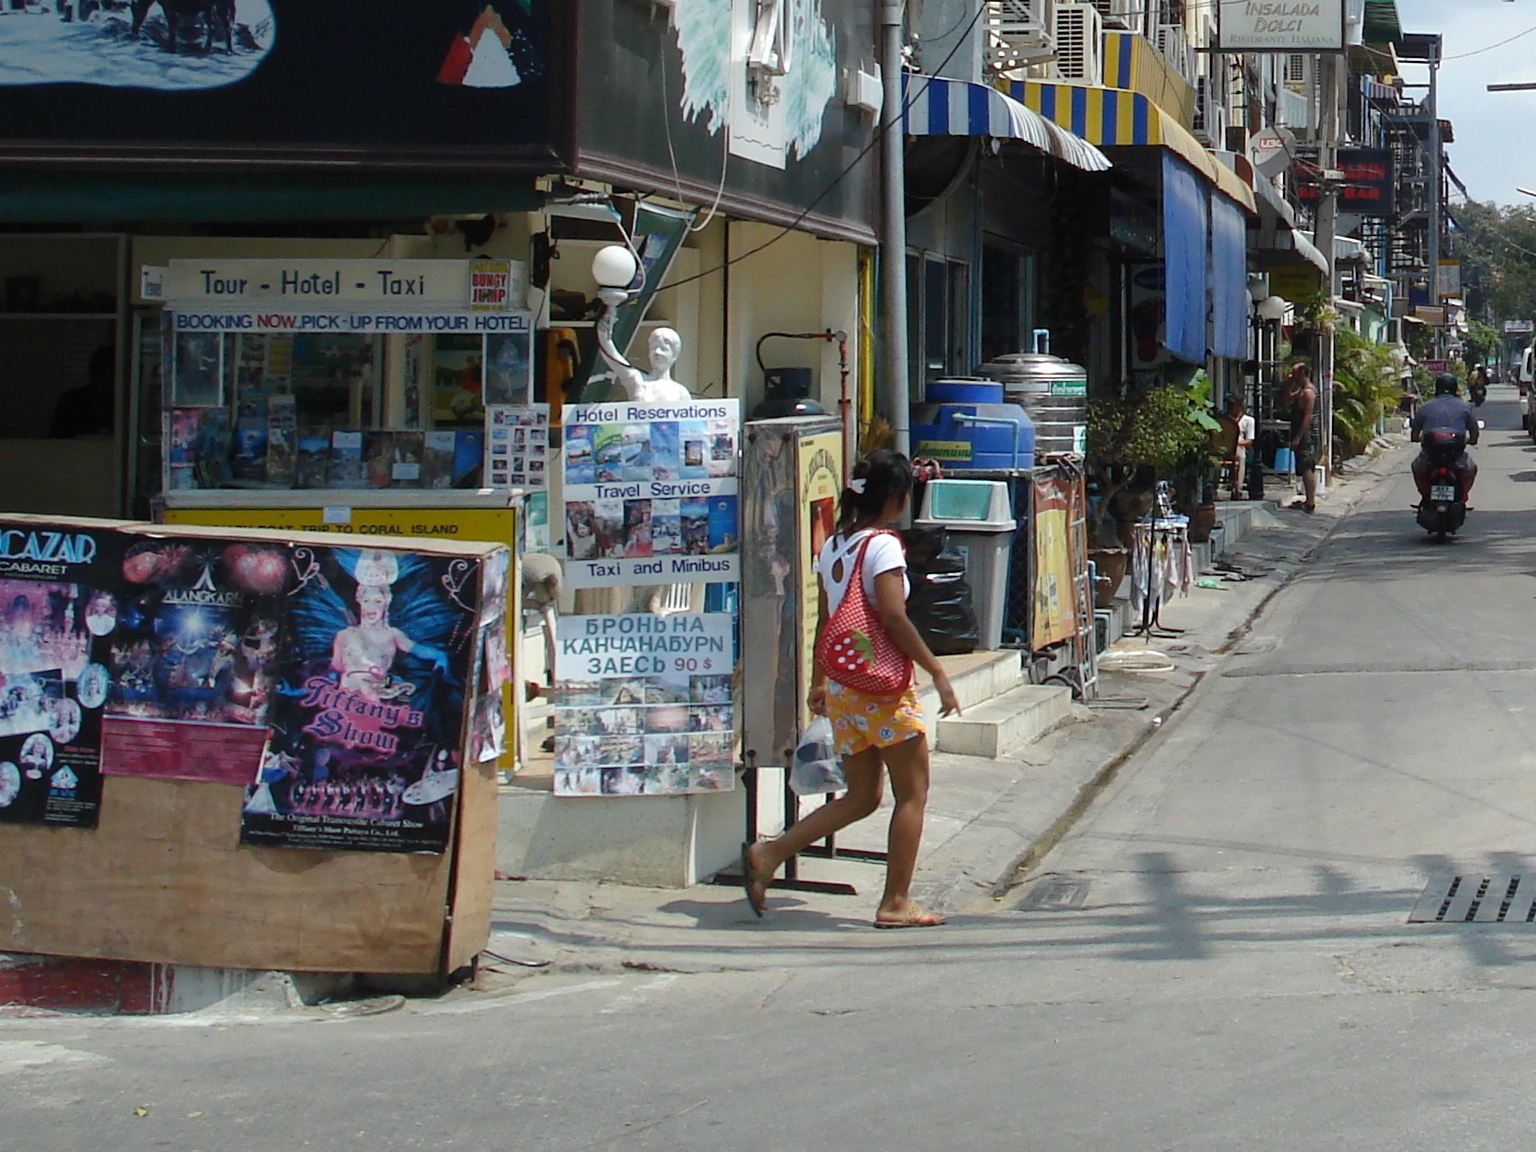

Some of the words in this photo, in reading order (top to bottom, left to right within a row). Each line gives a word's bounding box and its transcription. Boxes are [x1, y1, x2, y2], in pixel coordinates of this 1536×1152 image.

[1245, 2, 1320, 17] INSALADA
[1254, 17, 1302, 33] DOLCI
[200, 270, 247, 295] Tour
[281, 270, 340, 295] Hotel
[377, 270, 424, 295] Taxi
[472, 274, 506, 287] BUNGY
[472, 289, 506, 303] JUMP
[177, 314, 252, 329] BOOKING
[376, 316, 421, 330] FROM
[426, 316, 468, 330] YOUR
[475, 316, 528, 330] HOTEL
[576, 408, 618, 422] Hotel
[627, 405, 727, 420] Reservations
[595, 484, 640, 499] Travel
[650, 481, 711, 496] Service
[336, 525, 353, 534] TO
[360, 525, 404, 535] CORAL
[411, 525, 459, 535] ISLAND
[0, 529, 97, 564] CAZAR
[0, 561, 68, 575] CABARET
[587, 562, 621, 577] Taxi
[633, 560, 663, 575] and
[672, 558, 730, 573] Minibus
[673, 617, 705, 633] НА
[674, 658, 698, 671] 90
[301, 676, 422, 727] Tiffany's
[307, 710, 396, 751] Show
[270, 813, 286, 821] The
[287, 814, 321, 824] Original
[402, 820, 424, 828] Show
